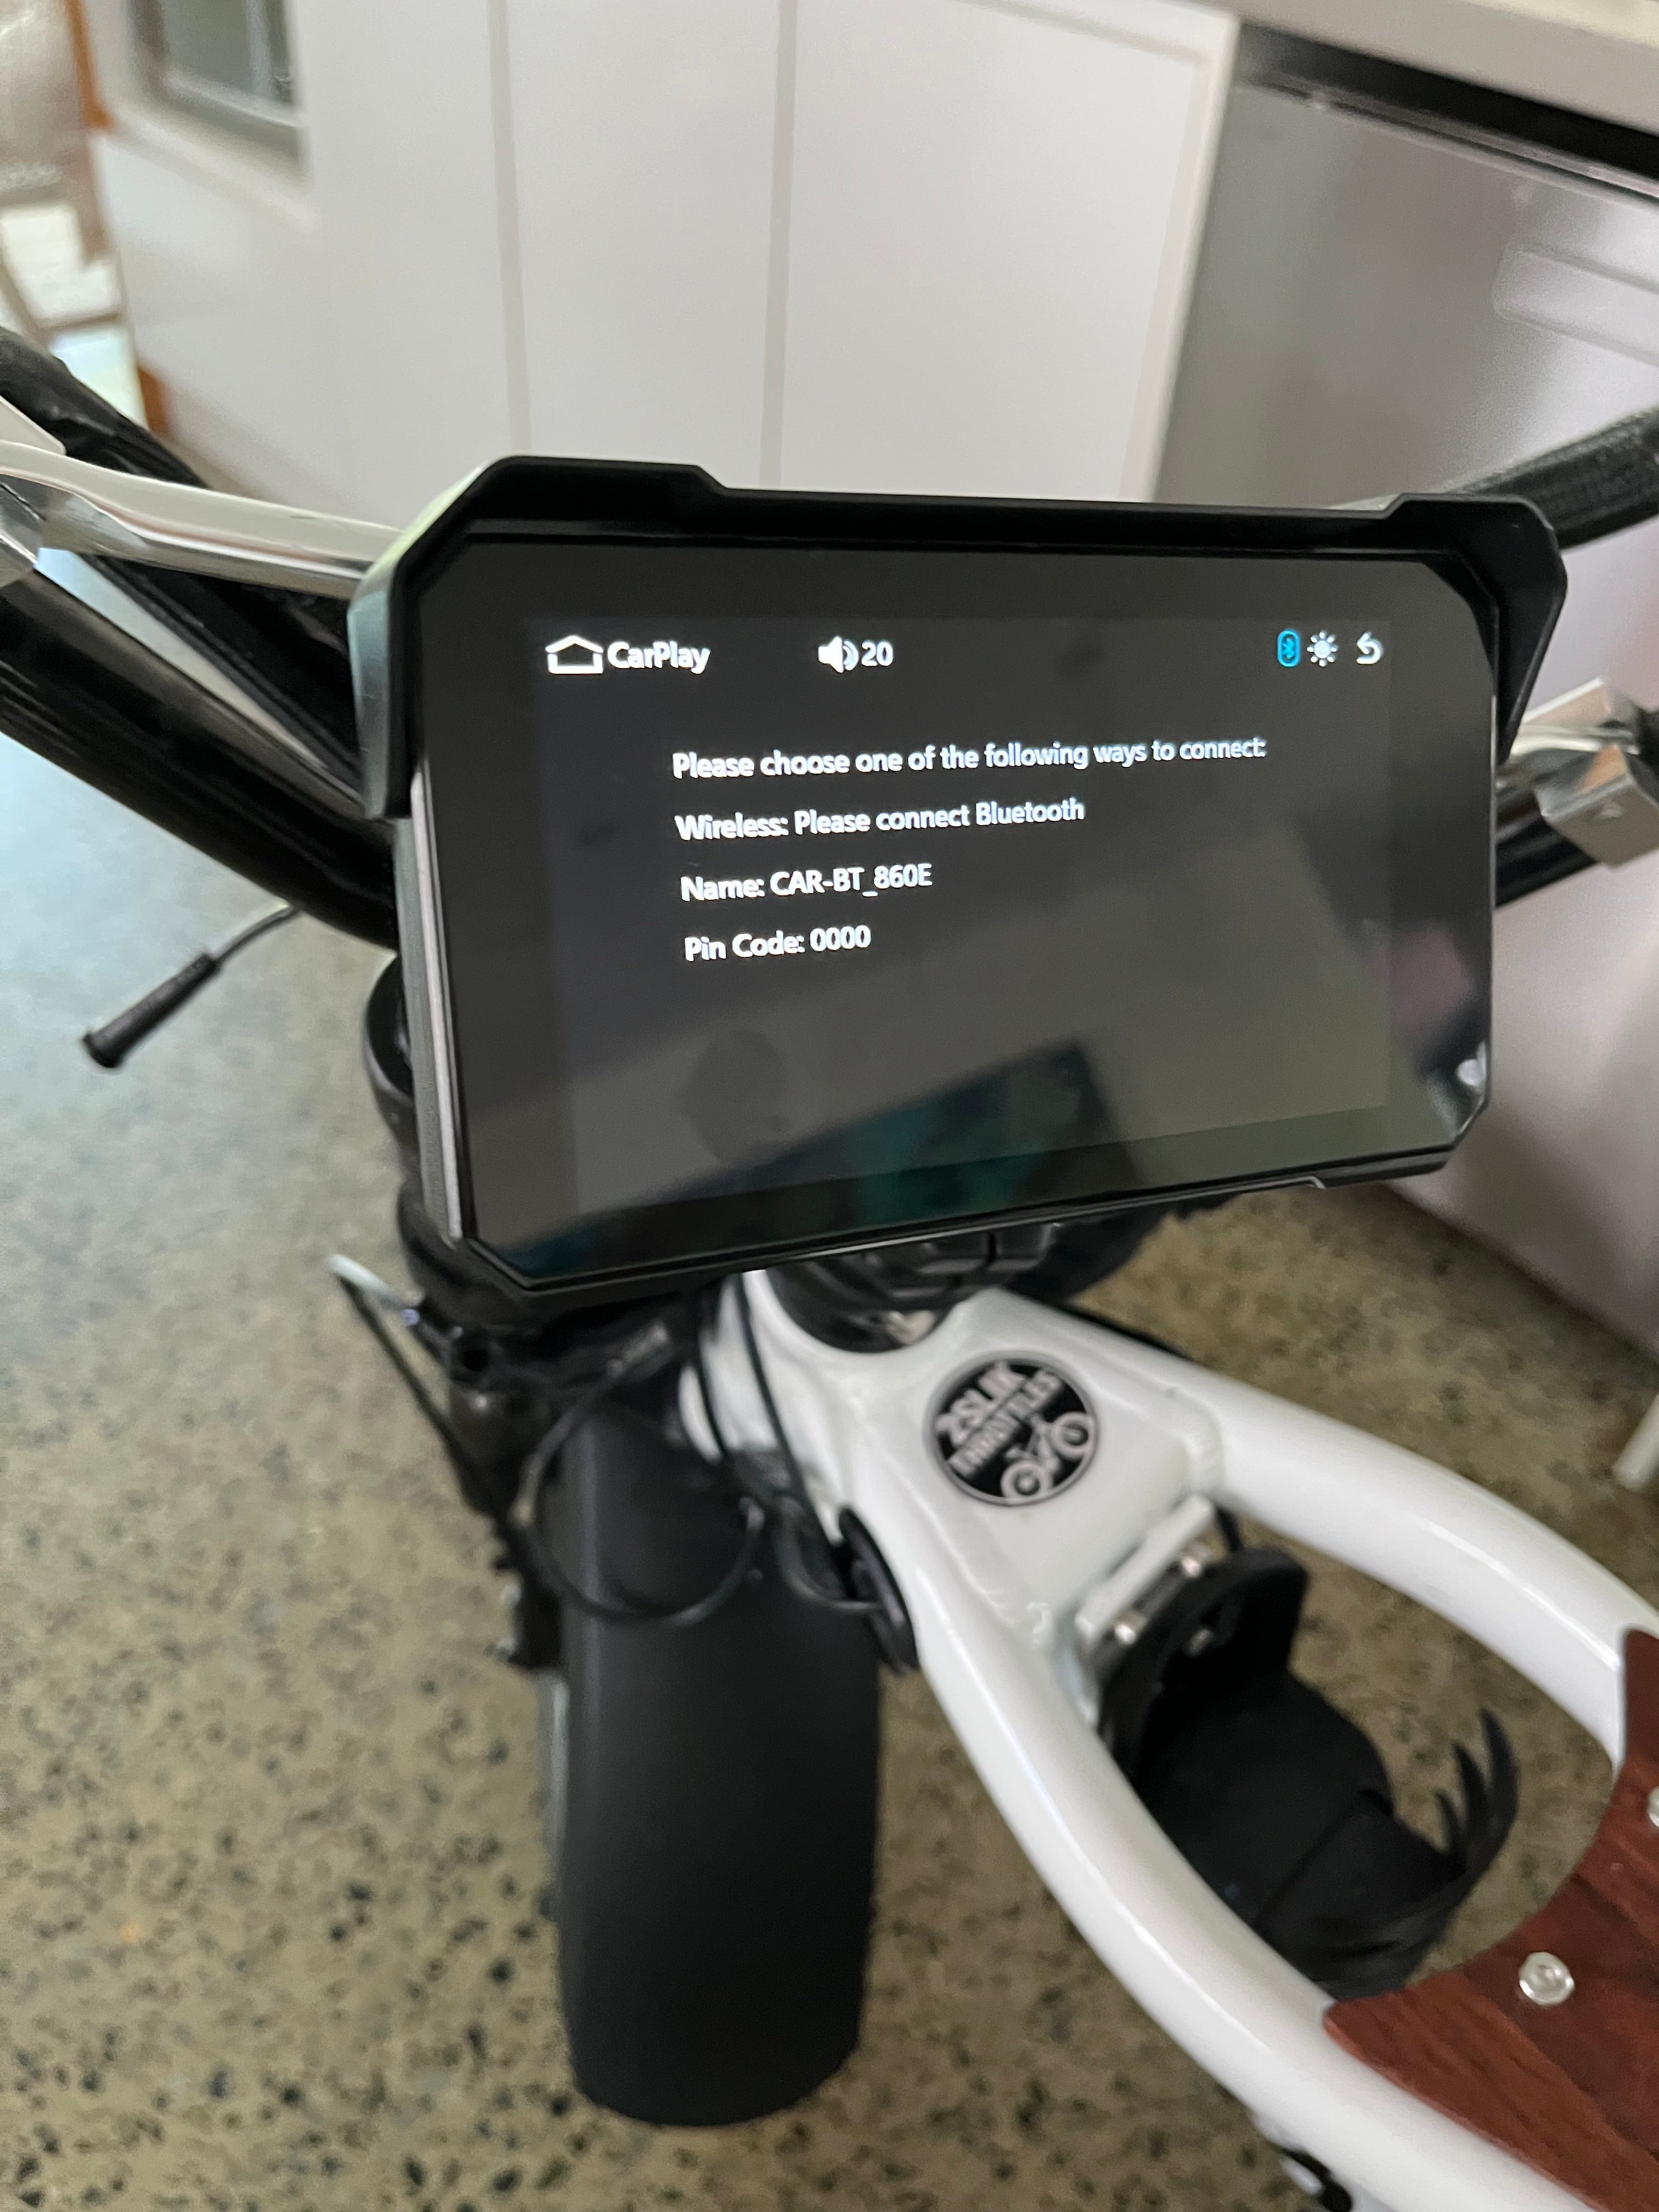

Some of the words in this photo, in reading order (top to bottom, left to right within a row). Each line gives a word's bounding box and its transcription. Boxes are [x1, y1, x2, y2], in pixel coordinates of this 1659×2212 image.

[607, 640, 711, 674] CarPlay
[861, 641, 894, 667] 20
[673, 752, 755, 778] Please
[760, 749, 850, 776] choose
[855, 751, 903, 774] one
[908, 744, 936, 771] of
[940, 744, 979, 769] the
[984, 741, 1089, 770] following
[1093, 742, 1147, 768] ways
[1151, 740, 1176, 761] to
[674, 812, 789, 840] Wireless:
[794, 809, 871, 836] Please
[876, 805, 970, 831] connect
[975, 797, 1085, 826] Bluetooth
[680, 876, 765, 901] Name:
[770, 863, 933, 897] CAR-BT_860E
[684, 936, 727, 961] Pin
[732, 930, 805, 958] Code:
[809, 925, 872, 952] 0000
